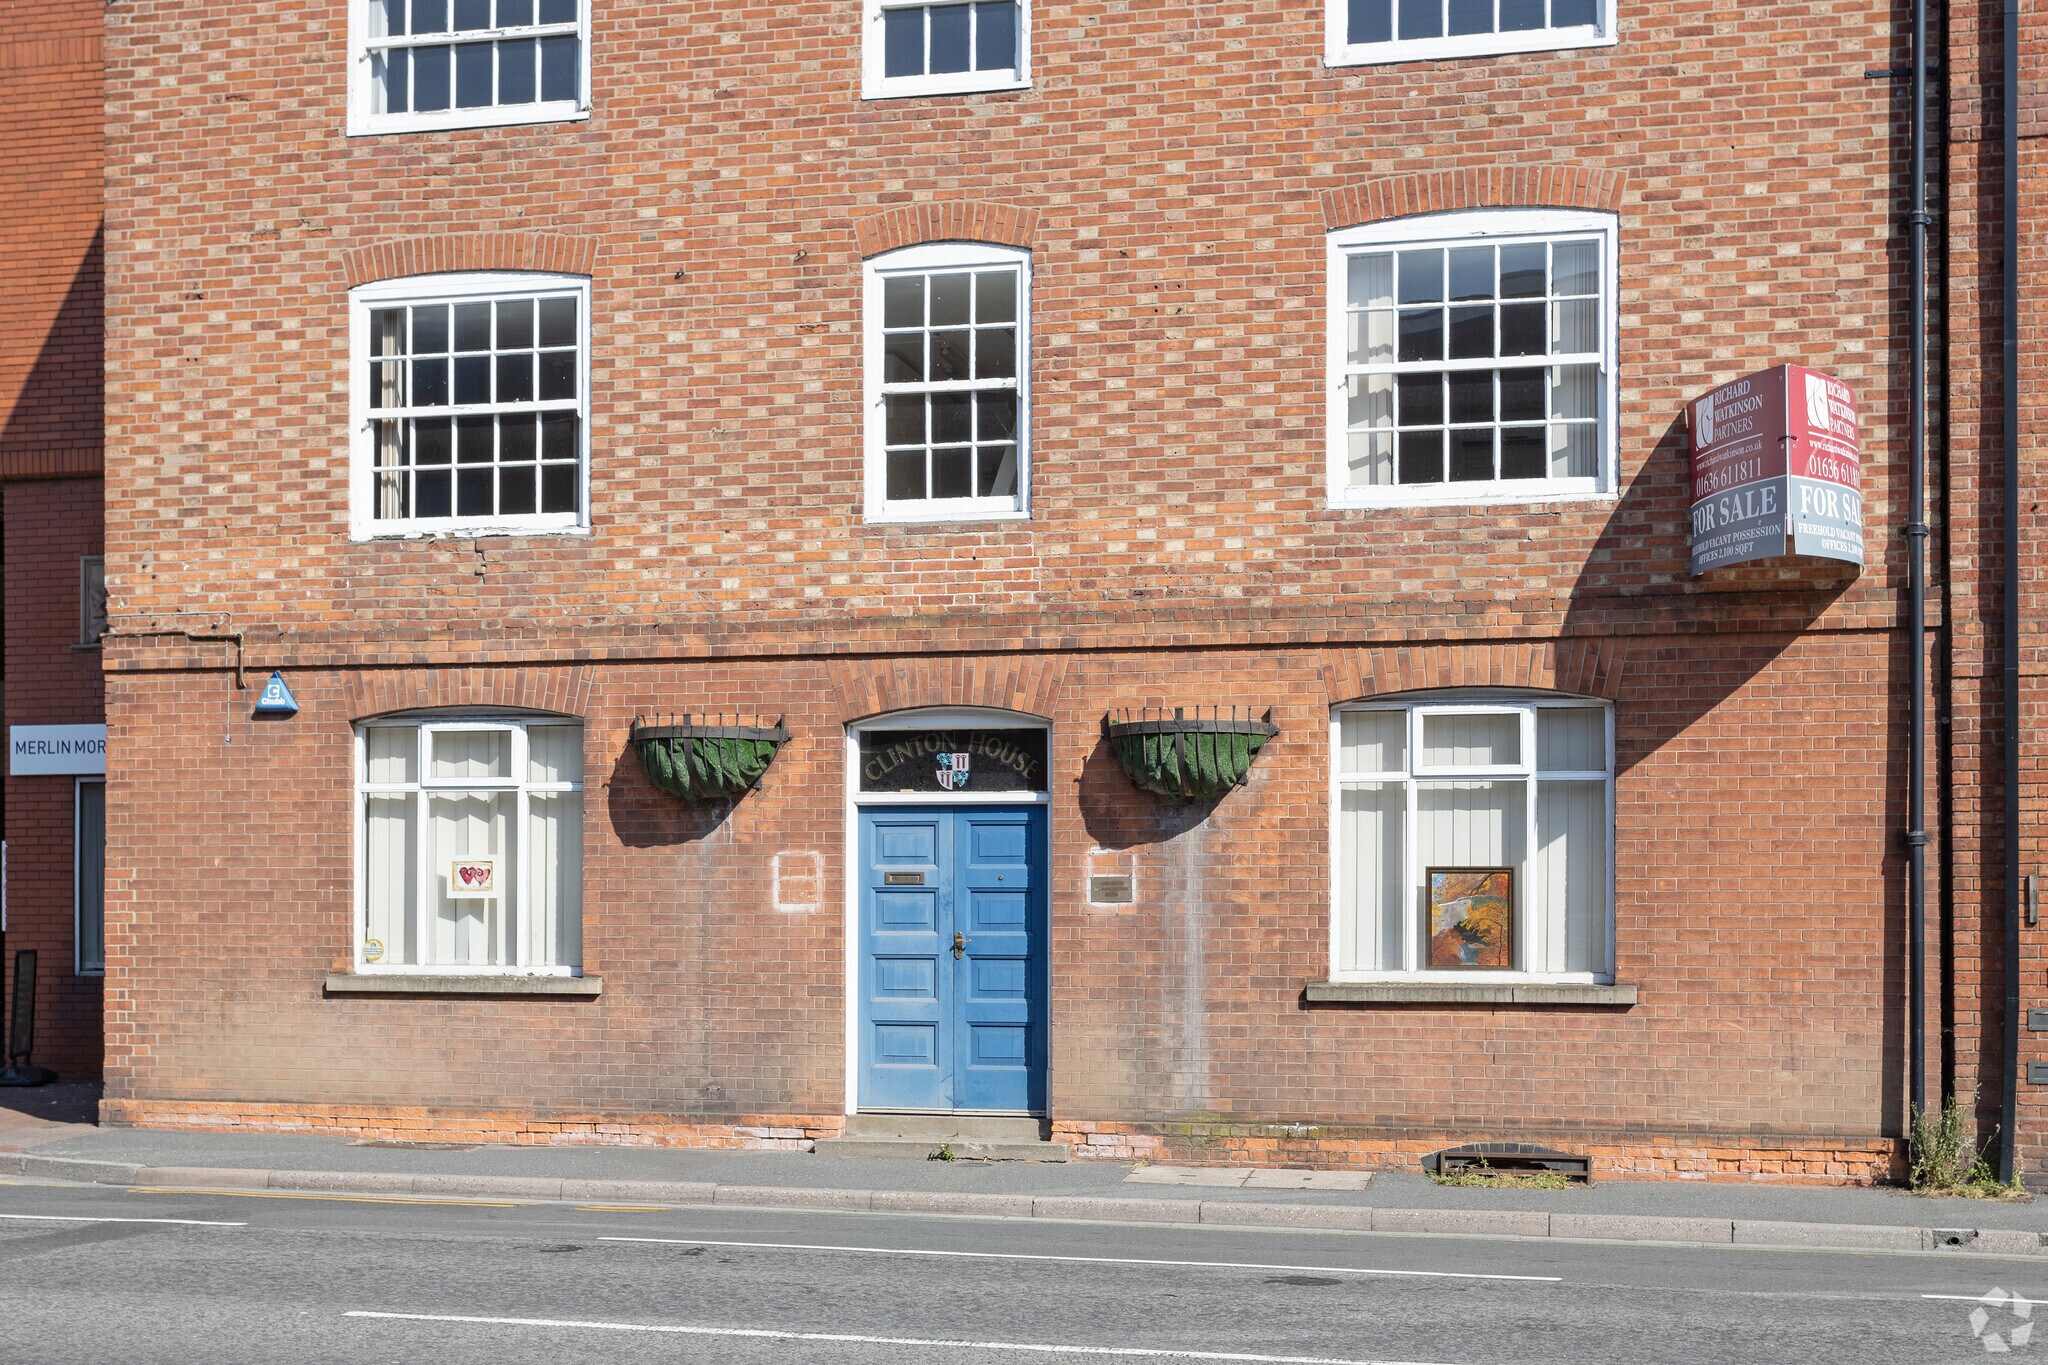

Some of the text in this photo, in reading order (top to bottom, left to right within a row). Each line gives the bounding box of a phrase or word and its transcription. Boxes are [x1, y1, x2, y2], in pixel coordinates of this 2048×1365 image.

[1714, 380, 1751, 406] RICHARD
[1826, 380, 1851, 404] RICHARD
[1714, 394, 1764, 424] WATKINSON
[1827, 398, 1857, 426] WATKINSON
[1714, 416, 1753, 442] PARTNERS
[1829, 417, 1855, 441] PARTNERS
[1696, 457, 1762, 498] 01636 611811
[1809, 454, 1839, 481] 01636
[1692, 485, 1777, 538] FOR SALE
[1799, 484, 1840, 519] FOR
[1709, 533, 1731, 550] VACANT
[1732, 523, 1781, 542] POSSESSION
[1797, 522, 1836, 538] FREEHOLD
[1698, 541, 1754, 565] OFFICES 2,100 SQFT
[1821, 538, 1847, 552] OFFICES
[261, 697, 286, 706] Chubb
[15, 739, 106, 755] MERLIN MOR
[865, 732, 1039, 781] CLINTON HOUSE
